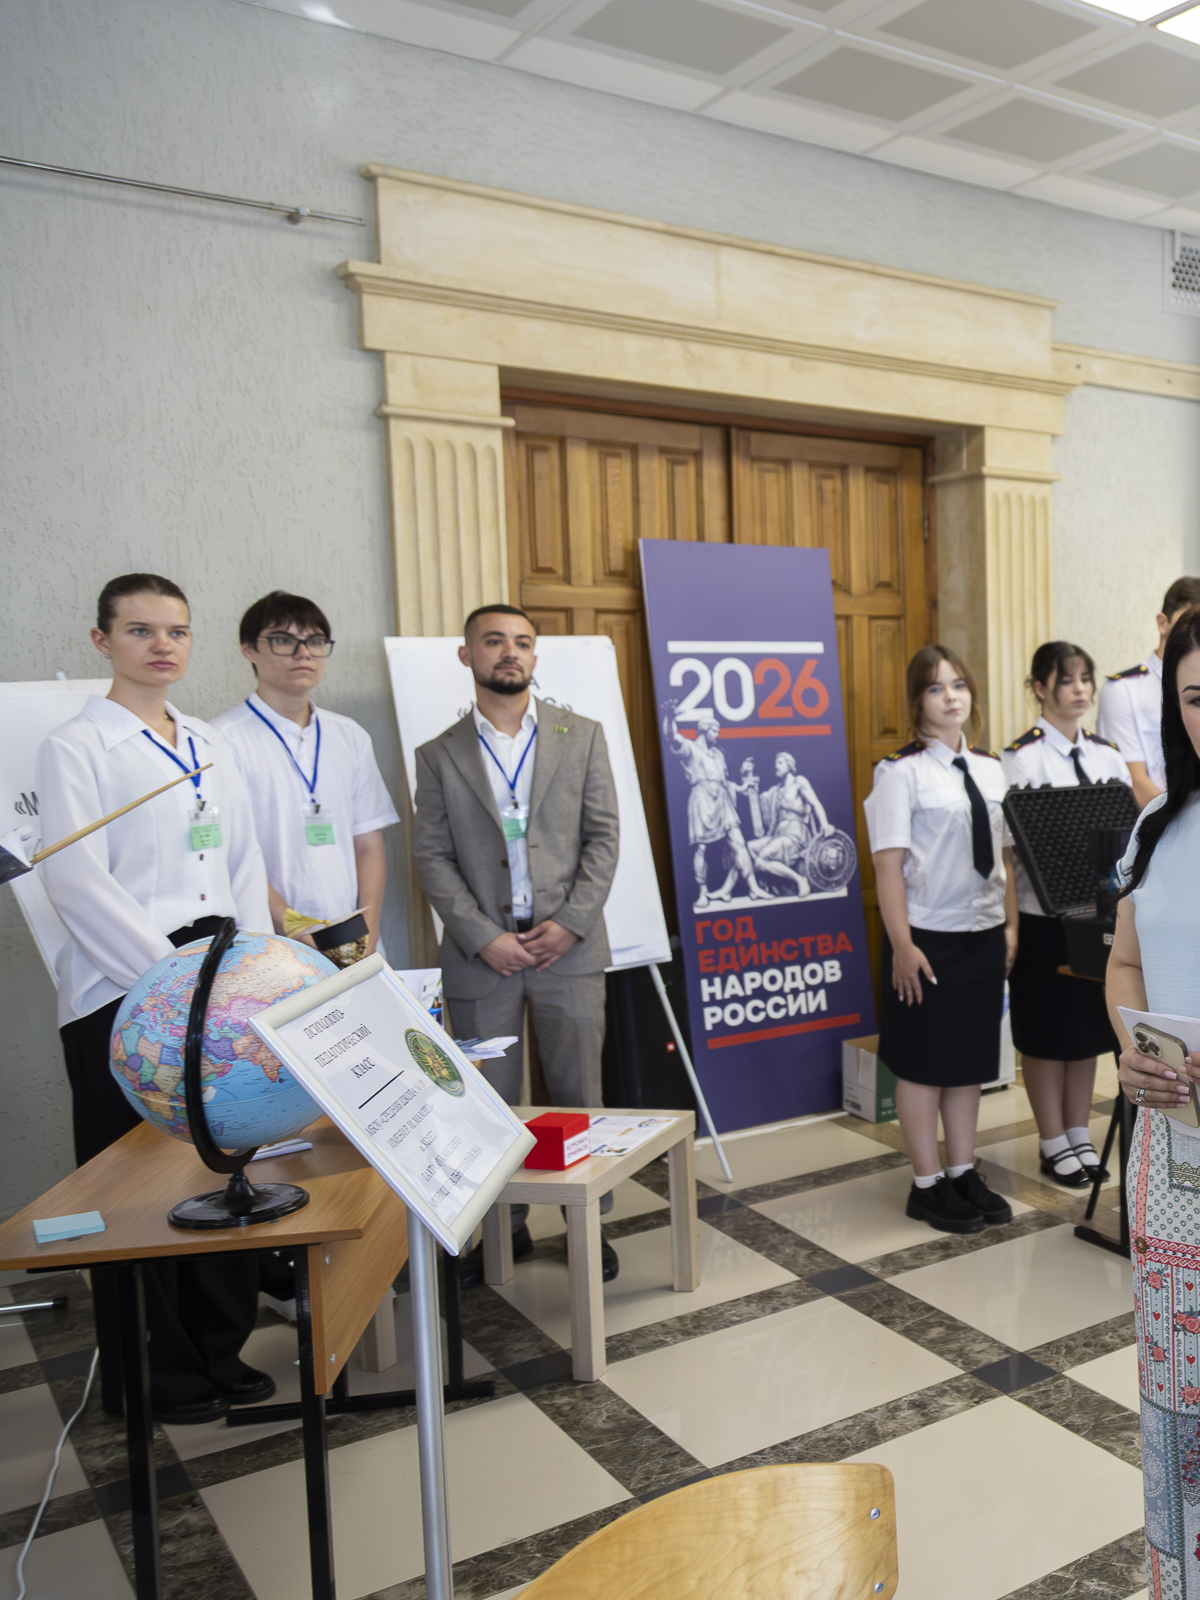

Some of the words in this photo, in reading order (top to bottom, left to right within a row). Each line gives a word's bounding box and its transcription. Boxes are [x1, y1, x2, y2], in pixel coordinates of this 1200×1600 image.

[669, 657, 830, 722] 2026
[695, 915, 757, 944] ГОД
[697, 931, 853, 975] ЕДИНСТВА
[700, 960, 842, 1002] НАРОДОВ
[303, 1009, 345, 1039] ПСИХОЛОГО-
[703, 989, 828, 1031] РОССИИ
[314, 1023, 372, 1068] ПЕДАГОГИЧЕСКИЙ
[351, 1056, 376, 1079] КЛАСС
